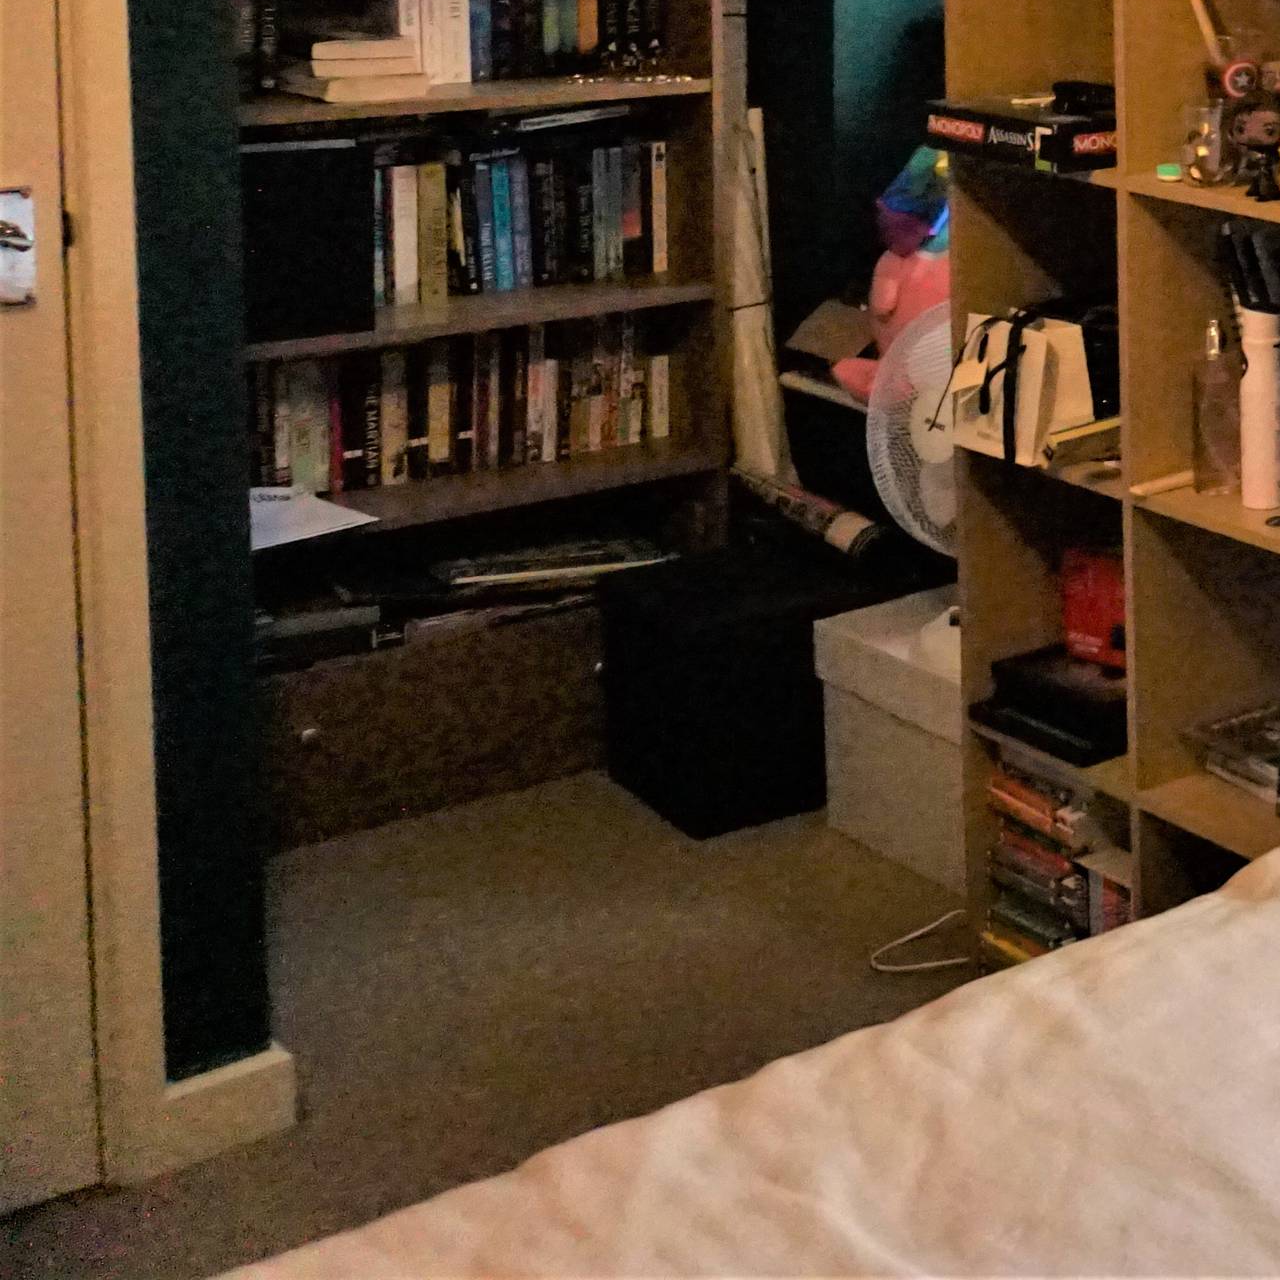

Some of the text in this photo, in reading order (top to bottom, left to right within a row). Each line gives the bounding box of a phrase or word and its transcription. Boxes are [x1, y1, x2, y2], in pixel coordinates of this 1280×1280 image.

[929, 117, 1035, 152] MONOPOLY ASSASSIN'S
[365, 410, 379, 469] MARTIAN
